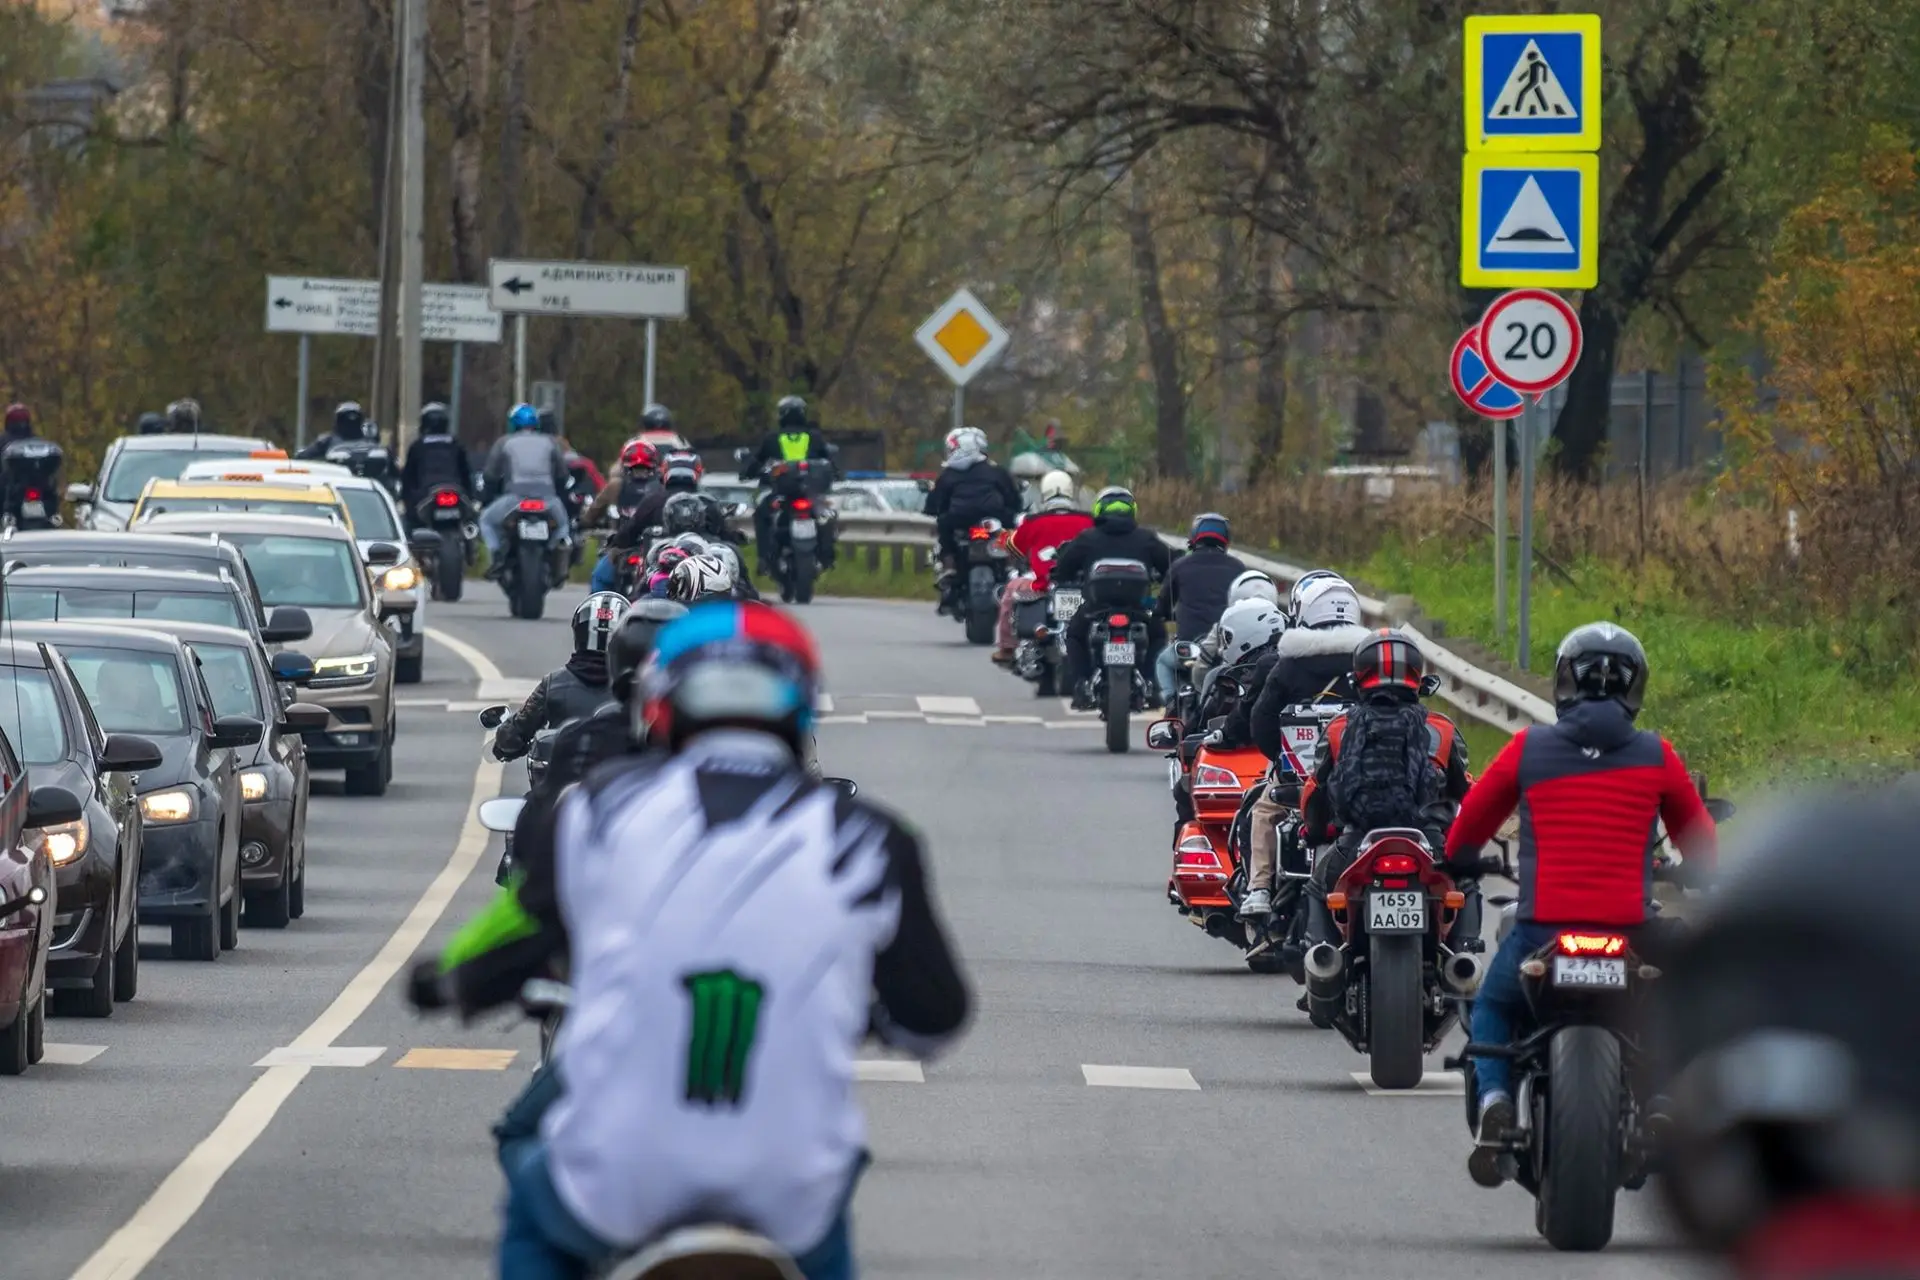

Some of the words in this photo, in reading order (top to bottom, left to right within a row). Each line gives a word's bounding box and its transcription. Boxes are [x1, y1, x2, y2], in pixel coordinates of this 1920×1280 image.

[541, 268, 676, 284] АДМИНИСТРАЦИЯ
[1505, 321, 1557, 360] 20
[1377, 894, 1416, 907] 1659
[1401, 913, 1420, 927] 09
